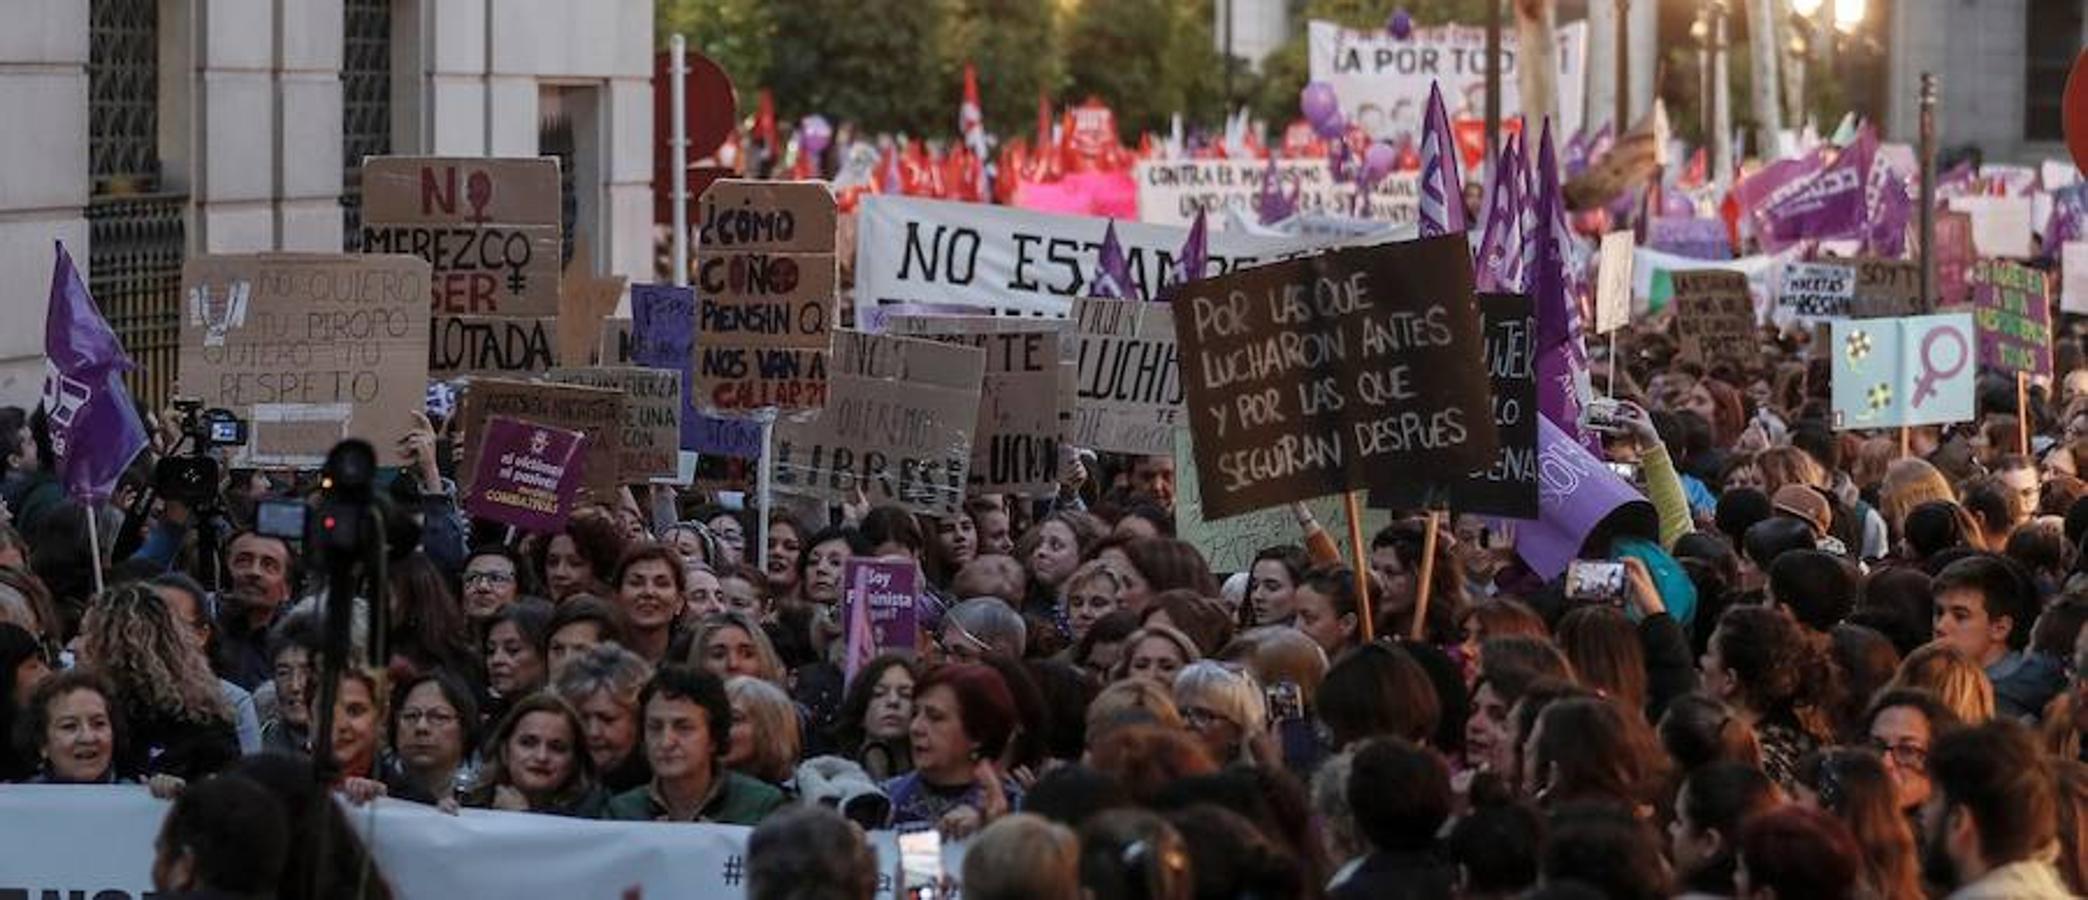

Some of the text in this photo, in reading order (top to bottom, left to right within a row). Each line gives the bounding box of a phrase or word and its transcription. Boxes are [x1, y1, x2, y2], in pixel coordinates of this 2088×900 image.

[897, 221, 981, 286] NO
[307, 308, 409, 340] PIROPO
[799, 300, 824, 334] Q
[1193, 271, 1375, 342] POR LAS QUE
[1200, 305, 1452, 389] LUCHARON ANTES
[220, 371, 380, 406] RESPETO
[1209, 404, 1229, 437] Y
[1235, 388, 1286, 429] POR
[1299, 377, 1344, 416] LAS
[1357, 365, 1419, 403] QUE
[621, 428, 654, 447] CON
[1354, 407, 1468, 457] DESPUES
